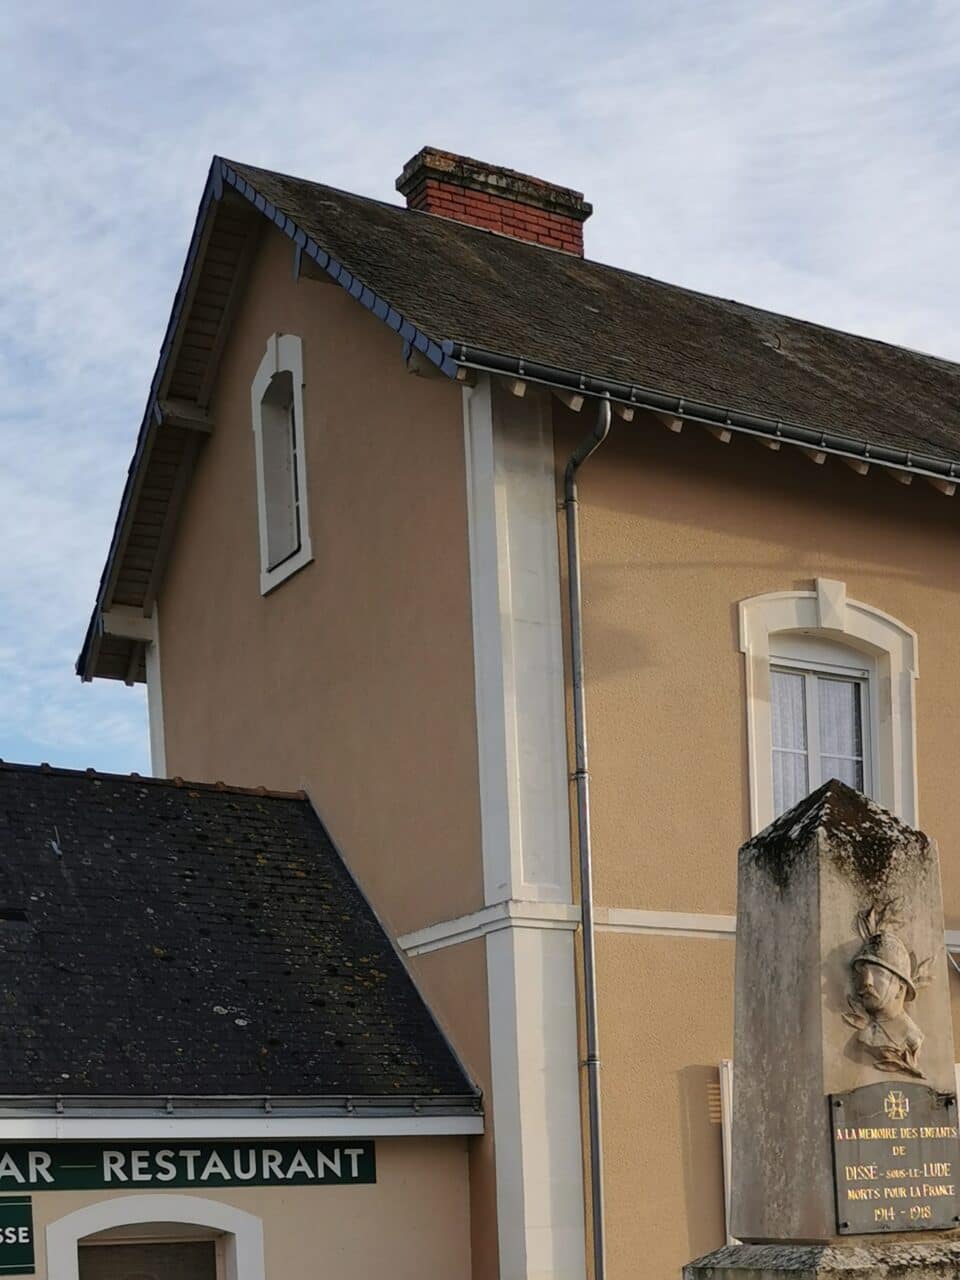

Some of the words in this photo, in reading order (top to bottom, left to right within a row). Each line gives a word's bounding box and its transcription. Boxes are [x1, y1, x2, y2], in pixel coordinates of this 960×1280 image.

[845, 1129, 856, 1139] LA
[901, 1127, 918, 1139] DES
[920, 1126, 957, 1138] ENFANTS
[893, 1146, 906, 1156] DE
[102, 1148, 365, 1182] RESTAURANT
[848, 1188, 880, 1200] MORTS
[884, 1187, 907, 1199] POUR
[910, 1186, 921, 1198] LA
[923, 1183, 956, 1197] FRANCE
[874, 1207, 895, 1221] 1914
[910, 1205, 932, 1220] 1918
[0, 1227, 30, 1244] SE
